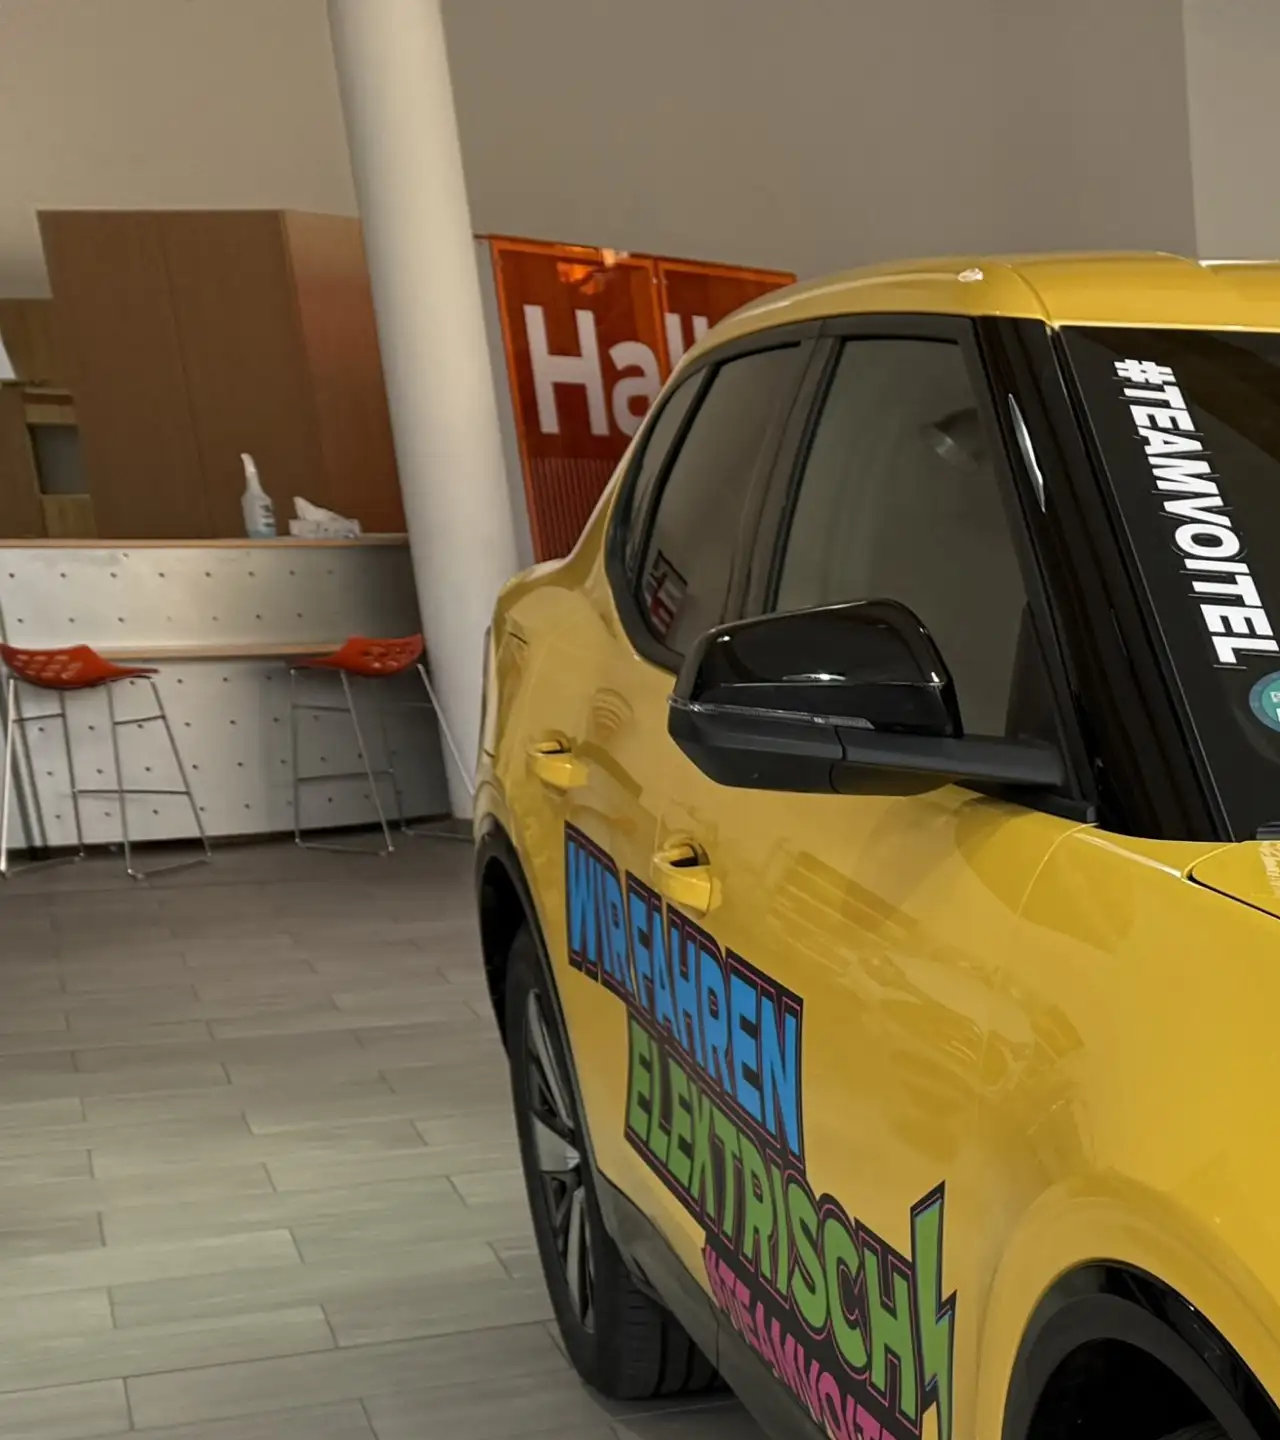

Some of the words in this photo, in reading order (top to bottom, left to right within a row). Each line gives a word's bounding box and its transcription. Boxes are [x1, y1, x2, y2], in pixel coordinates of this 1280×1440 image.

[1113, 359, 1280, 665] #TEAMVOITEL
[568, 840, 634, 993] WIR
[628, 891, 801, 1156] FAHREN
